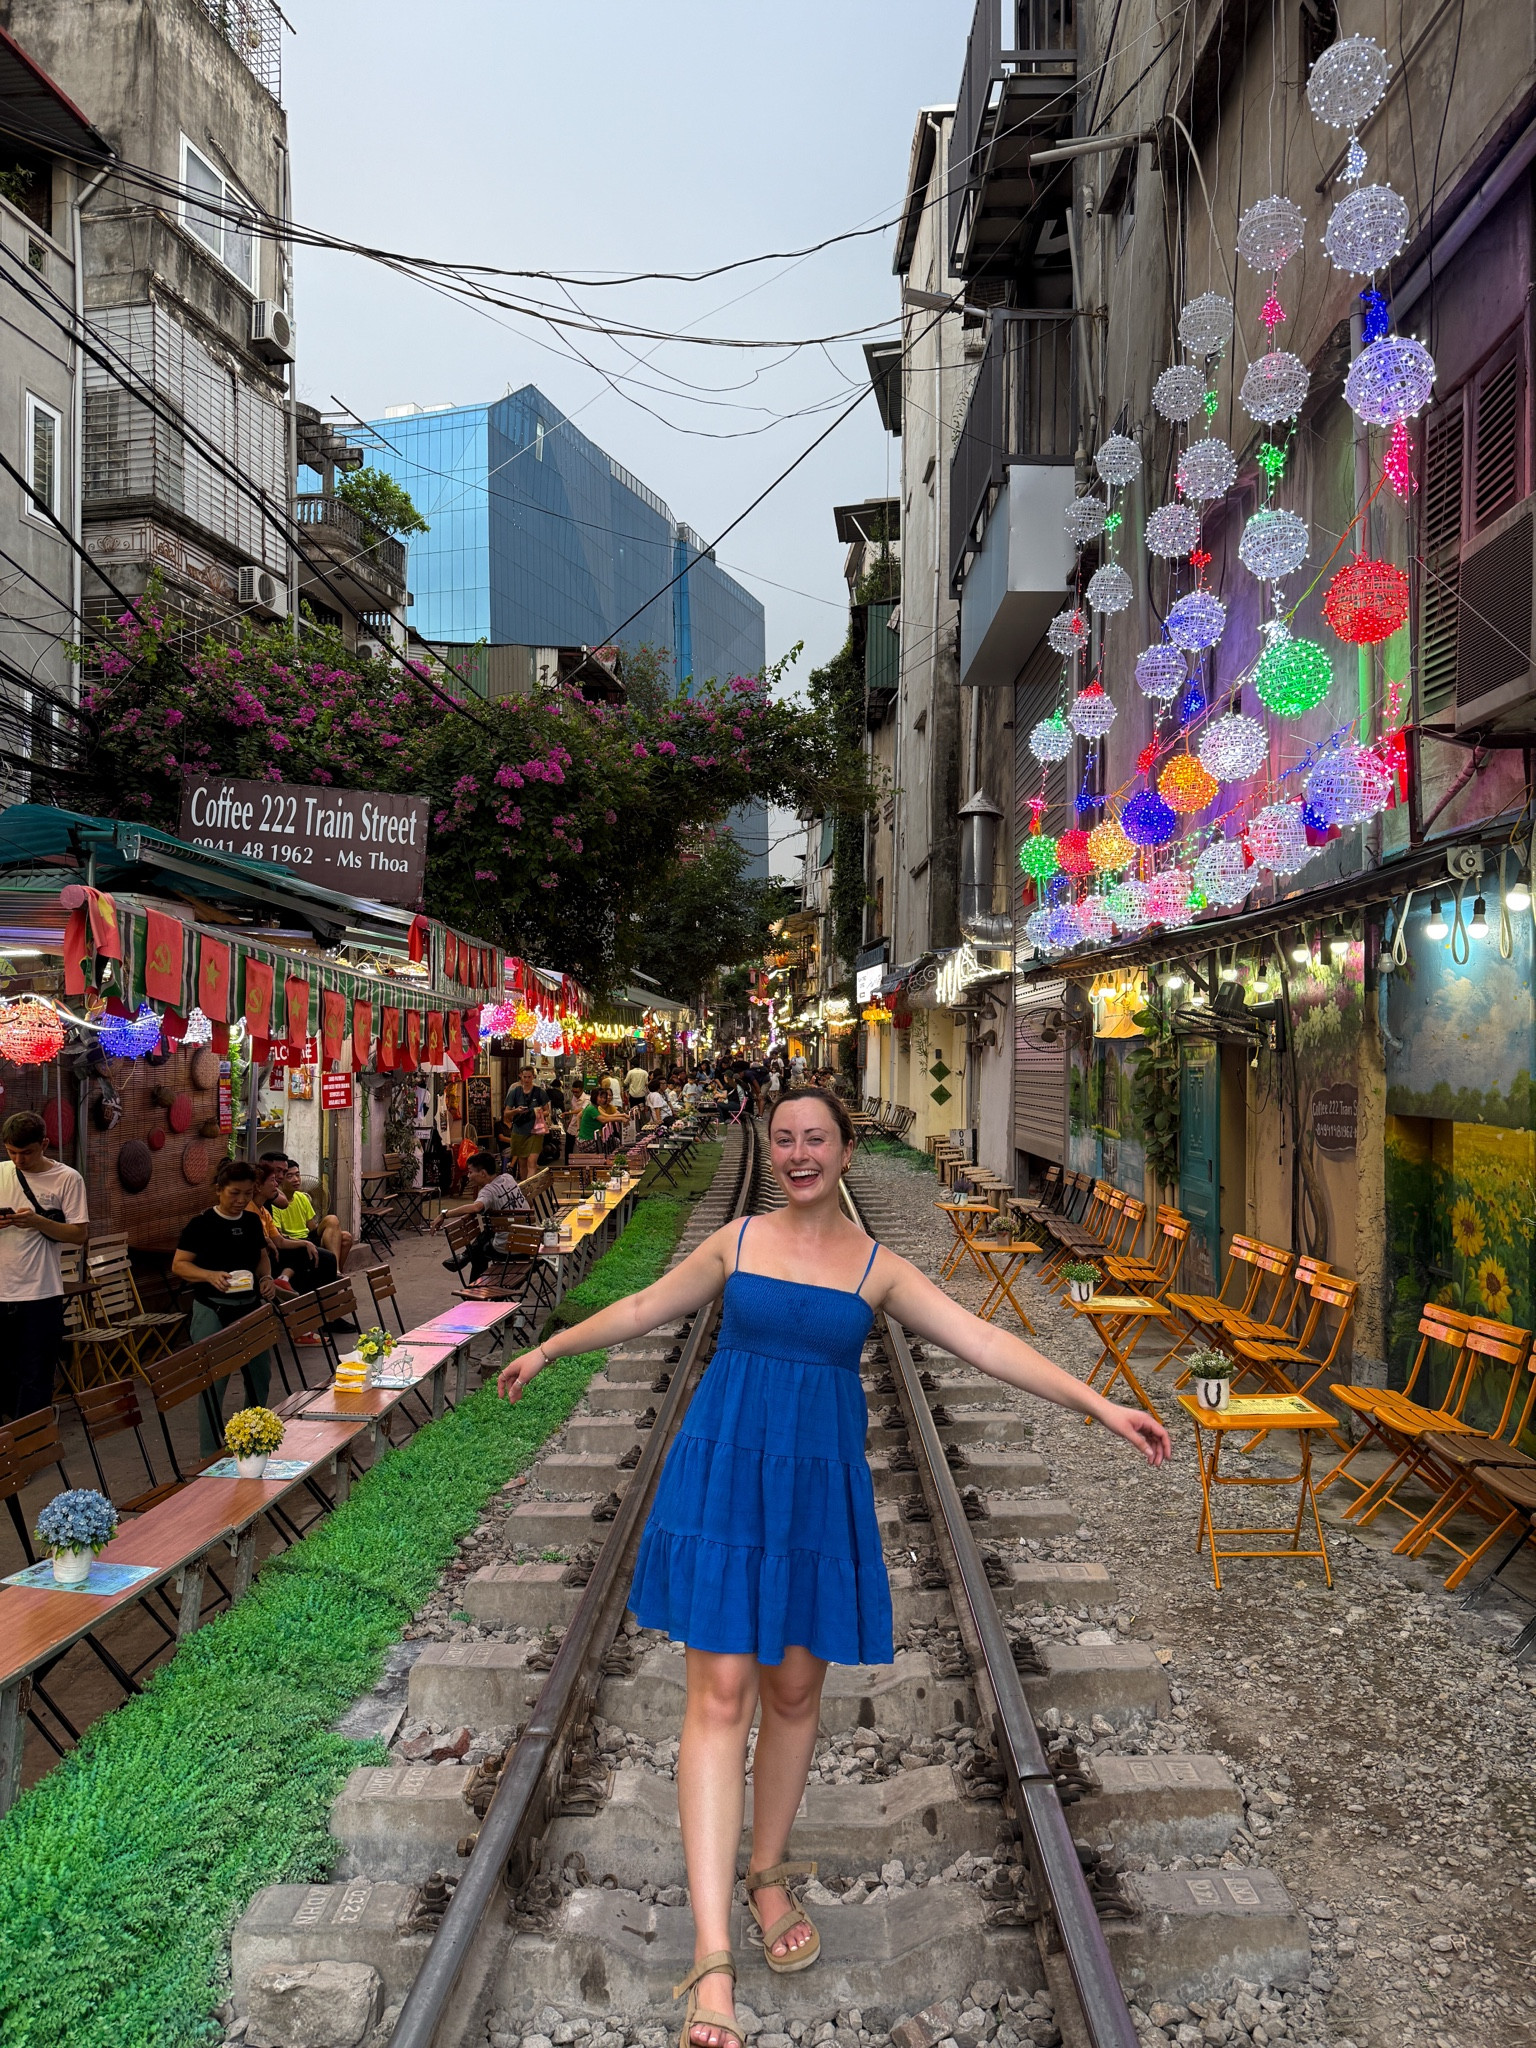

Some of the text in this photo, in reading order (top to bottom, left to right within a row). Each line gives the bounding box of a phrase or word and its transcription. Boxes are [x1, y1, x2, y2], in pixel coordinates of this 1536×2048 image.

[191, 786, 417, 846] Coffee 222 Train Street
[241, 841, 264, 860] 48
[270, 844, 313, 865] 1962
[336, 850, 362, 869] Ms
[368, 851, 409, 873] Thoa
[340, 1889, 367, 1922] 0323
